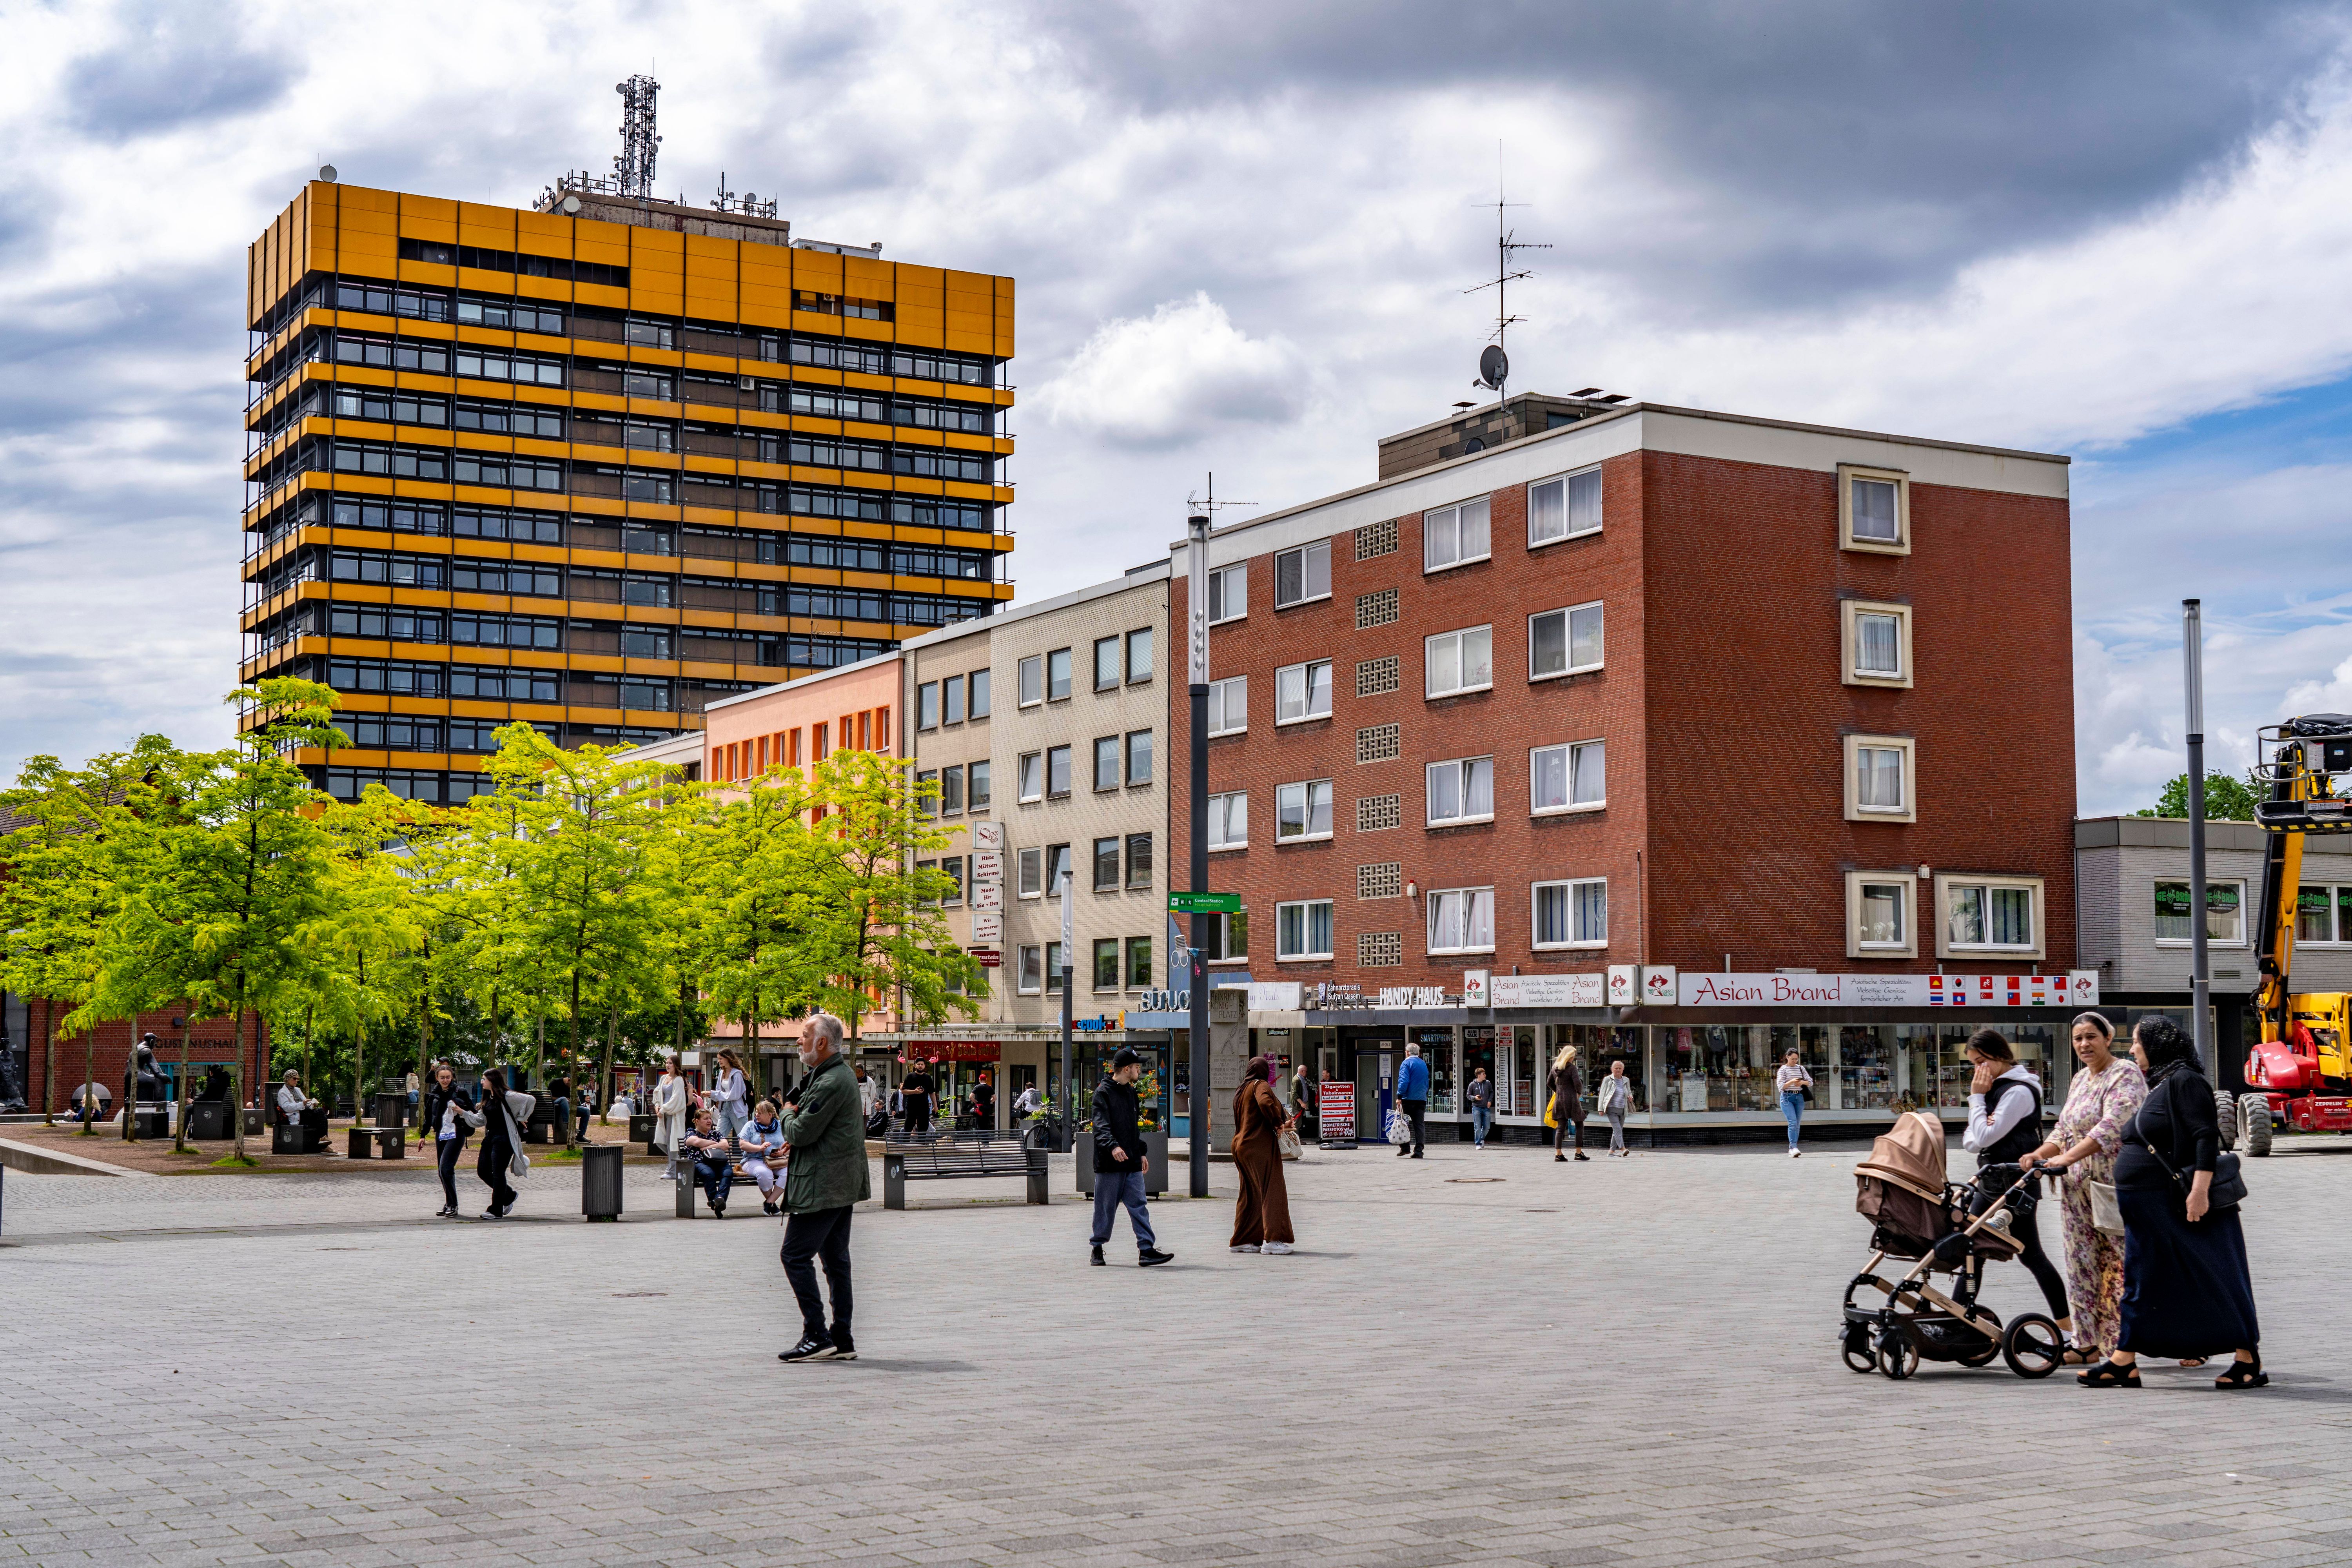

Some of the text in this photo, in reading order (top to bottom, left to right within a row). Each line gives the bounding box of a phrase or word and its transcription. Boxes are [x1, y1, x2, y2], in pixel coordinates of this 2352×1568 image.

[1327, 983, 1361, 991] Zahnarztpraxis
[1493, 978, 1519, 991] Asian
[1572, 976, 1599, 989] Asian
[1379, 986, 1445, 1005] HANDY HAUS
[1693, 976, 1840, 1004] Asian Brand
[1493, 992, 1520, 1005] Brand
[1572, 991, 1600, 1004] Brand
[155, 1039, 236, 1048] GUSTNUSHAU
